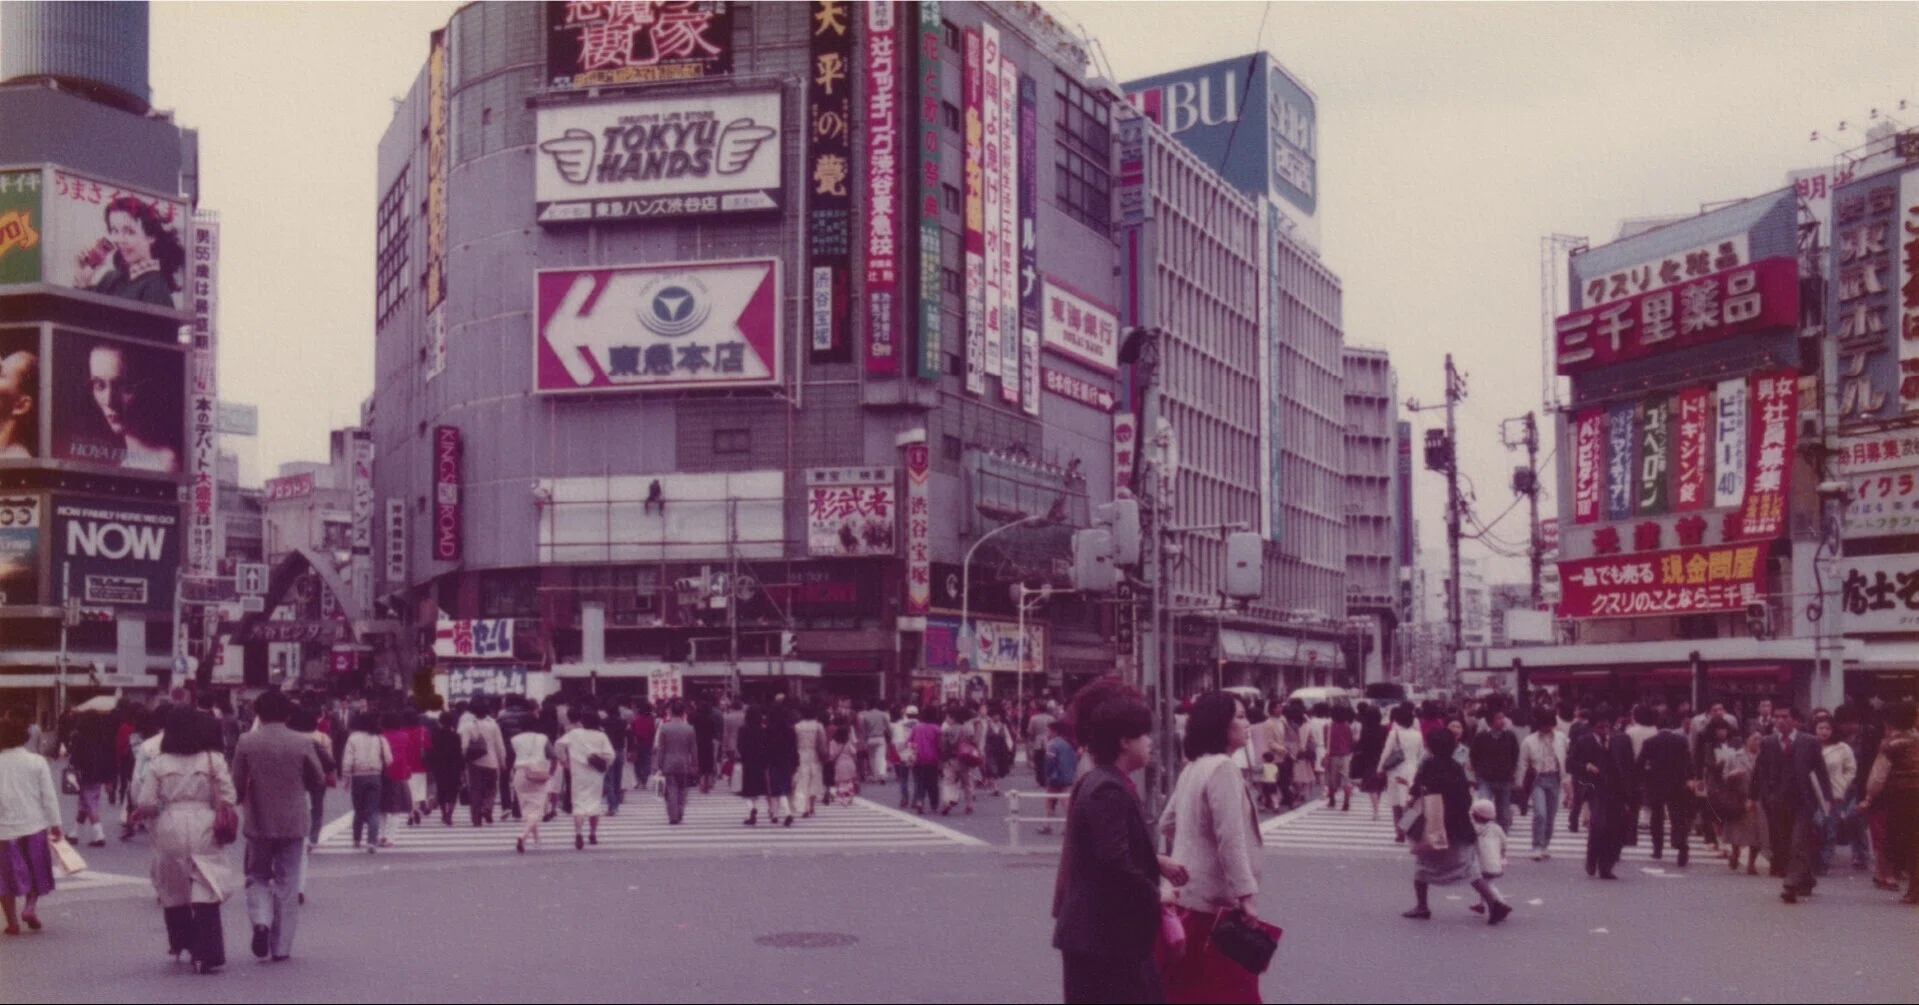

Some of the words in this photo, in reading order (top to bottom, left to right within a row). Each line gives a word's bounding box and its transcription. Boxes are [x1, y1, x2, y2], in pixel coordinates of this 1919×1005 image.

[604, 119, 720, 154] TOKYU
[597, 149, 712, 184] HANDS
[596, 197, 717, 218] 東急ハンズ渋谷店
[1587, 265, 1650, 301] クスリ
[1658, 240, 1741, 284] 化粧品
[1556, 268, 1763, 365] 三千里薬品
[608, 341, 745, 376] 東急本店
[1757, 377, 1794, 401] 男女
[1753, 400, 1790, 493] 社員募集
[810, 485, 894, 520] 影武者
[67, 519, 165, 561] NOW
[910, 495, 929, 585] 渋谷宝塚
[1569, 562, 1655, 587] 一品でも売る
[1660, 546, 1759, 585] 現金問屋
[1592, 583, 1756, 615] クスリのことなら三千里
